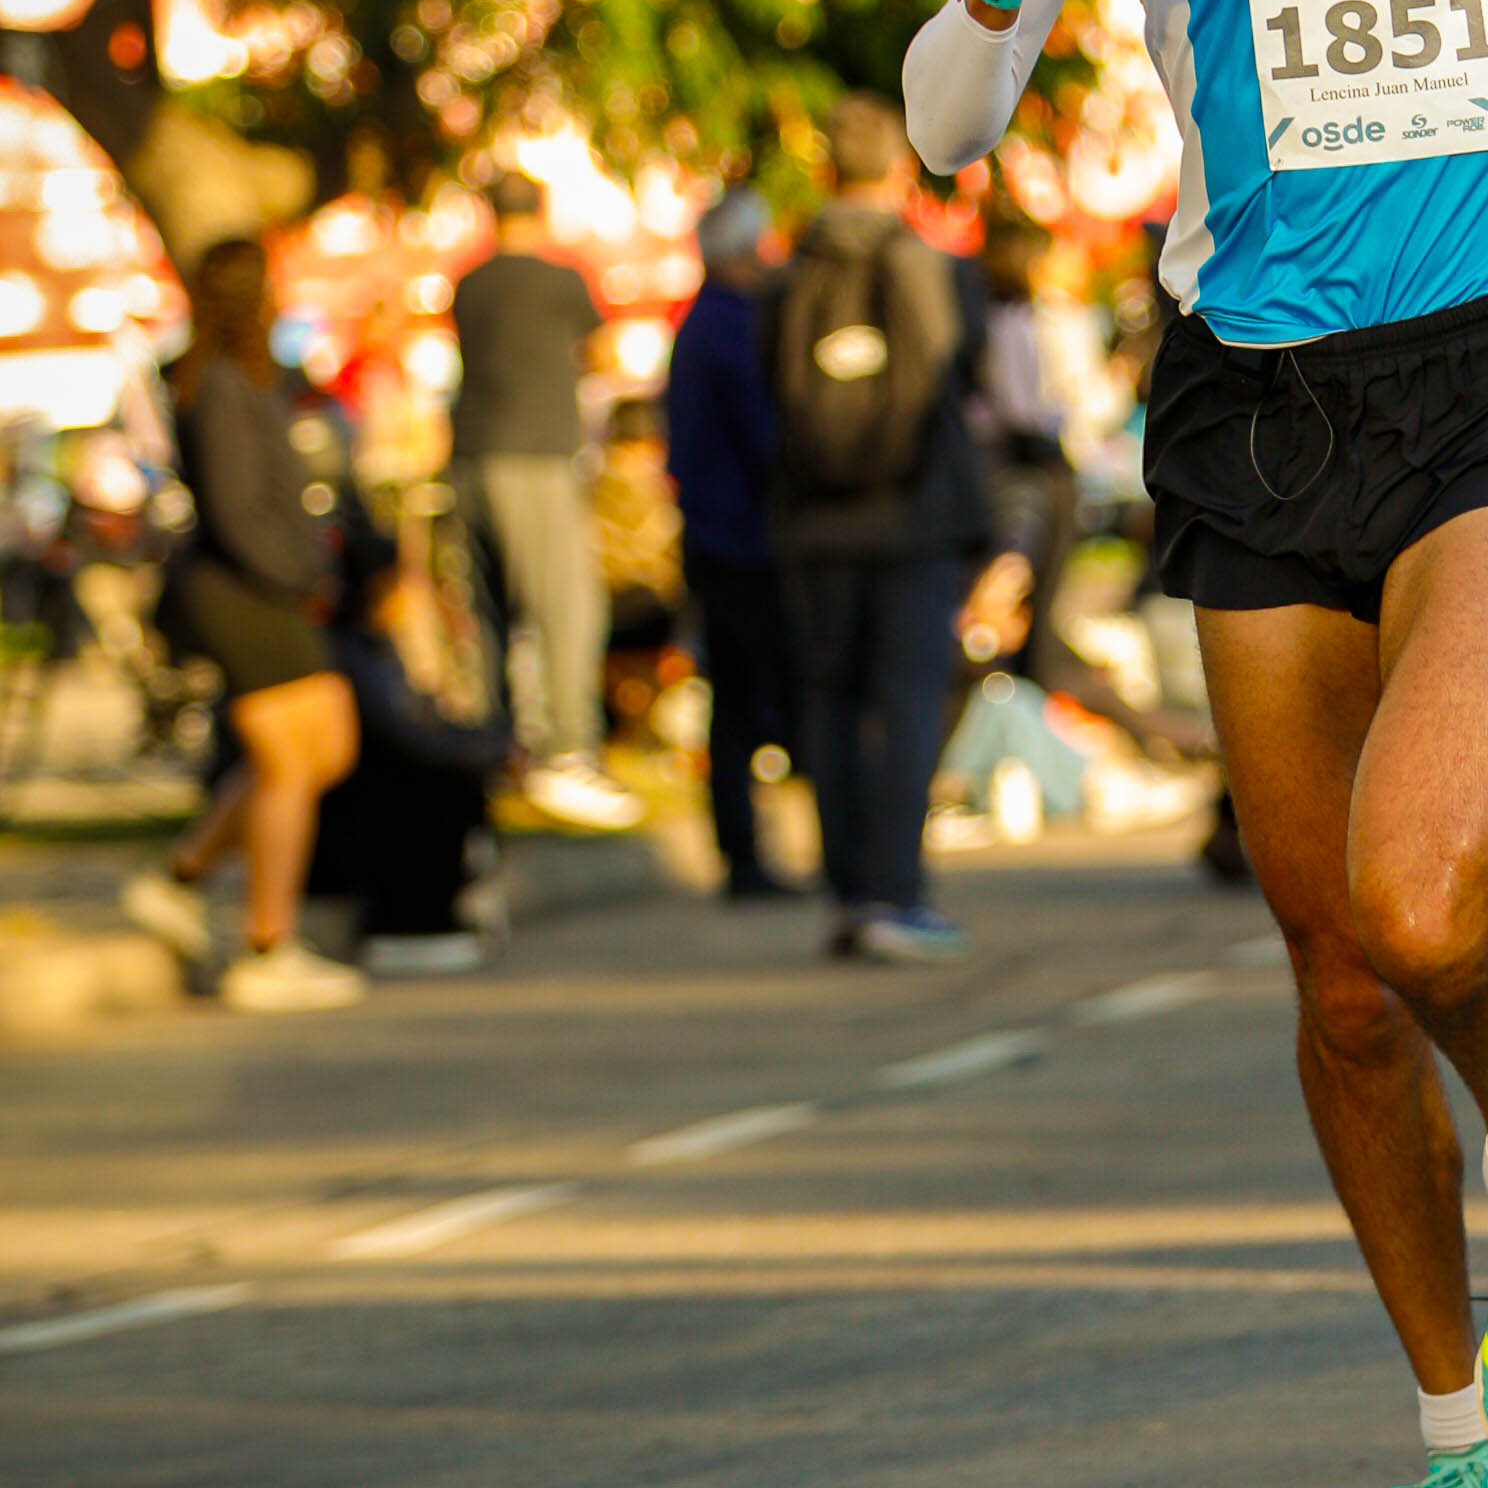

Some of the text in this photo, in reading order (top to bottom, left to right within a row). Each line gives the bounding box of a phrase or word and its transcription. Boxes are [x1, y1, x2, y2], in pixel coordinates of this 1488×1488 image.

[1310, 72, 1469, 102] Lencina Juan Manuel
[1301, 115, 1386, 149] osde
